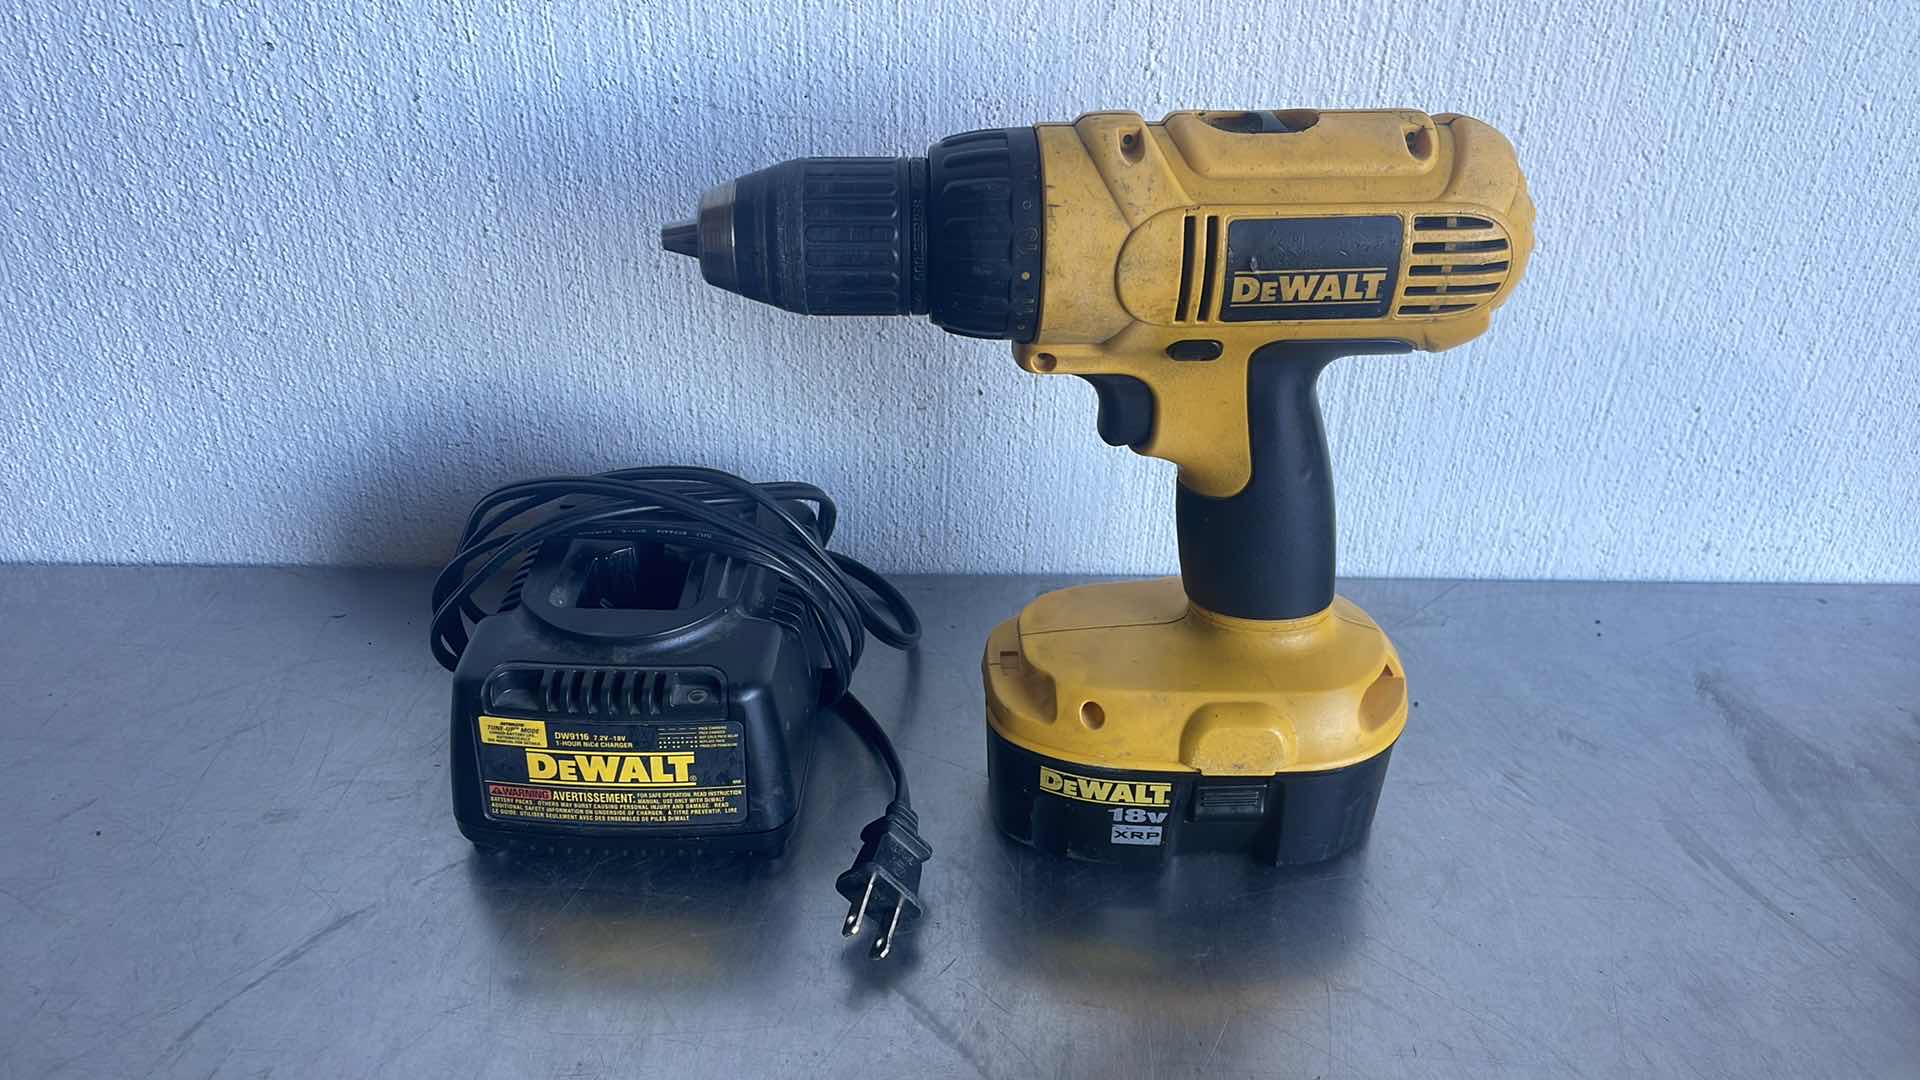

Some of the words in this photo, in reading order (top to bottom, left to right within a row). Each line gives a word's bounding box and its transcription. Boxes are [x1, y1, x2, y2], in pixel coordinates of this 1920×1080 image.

[554, 731, 590, 741] DW9116
[600, 741, 633, 749] CHARGER
[500, 786, 550, 799] WARNING
[553, 790, 637, 804] AVERTISSEMENT:
[1115, 830, 1160, 840] XRP
